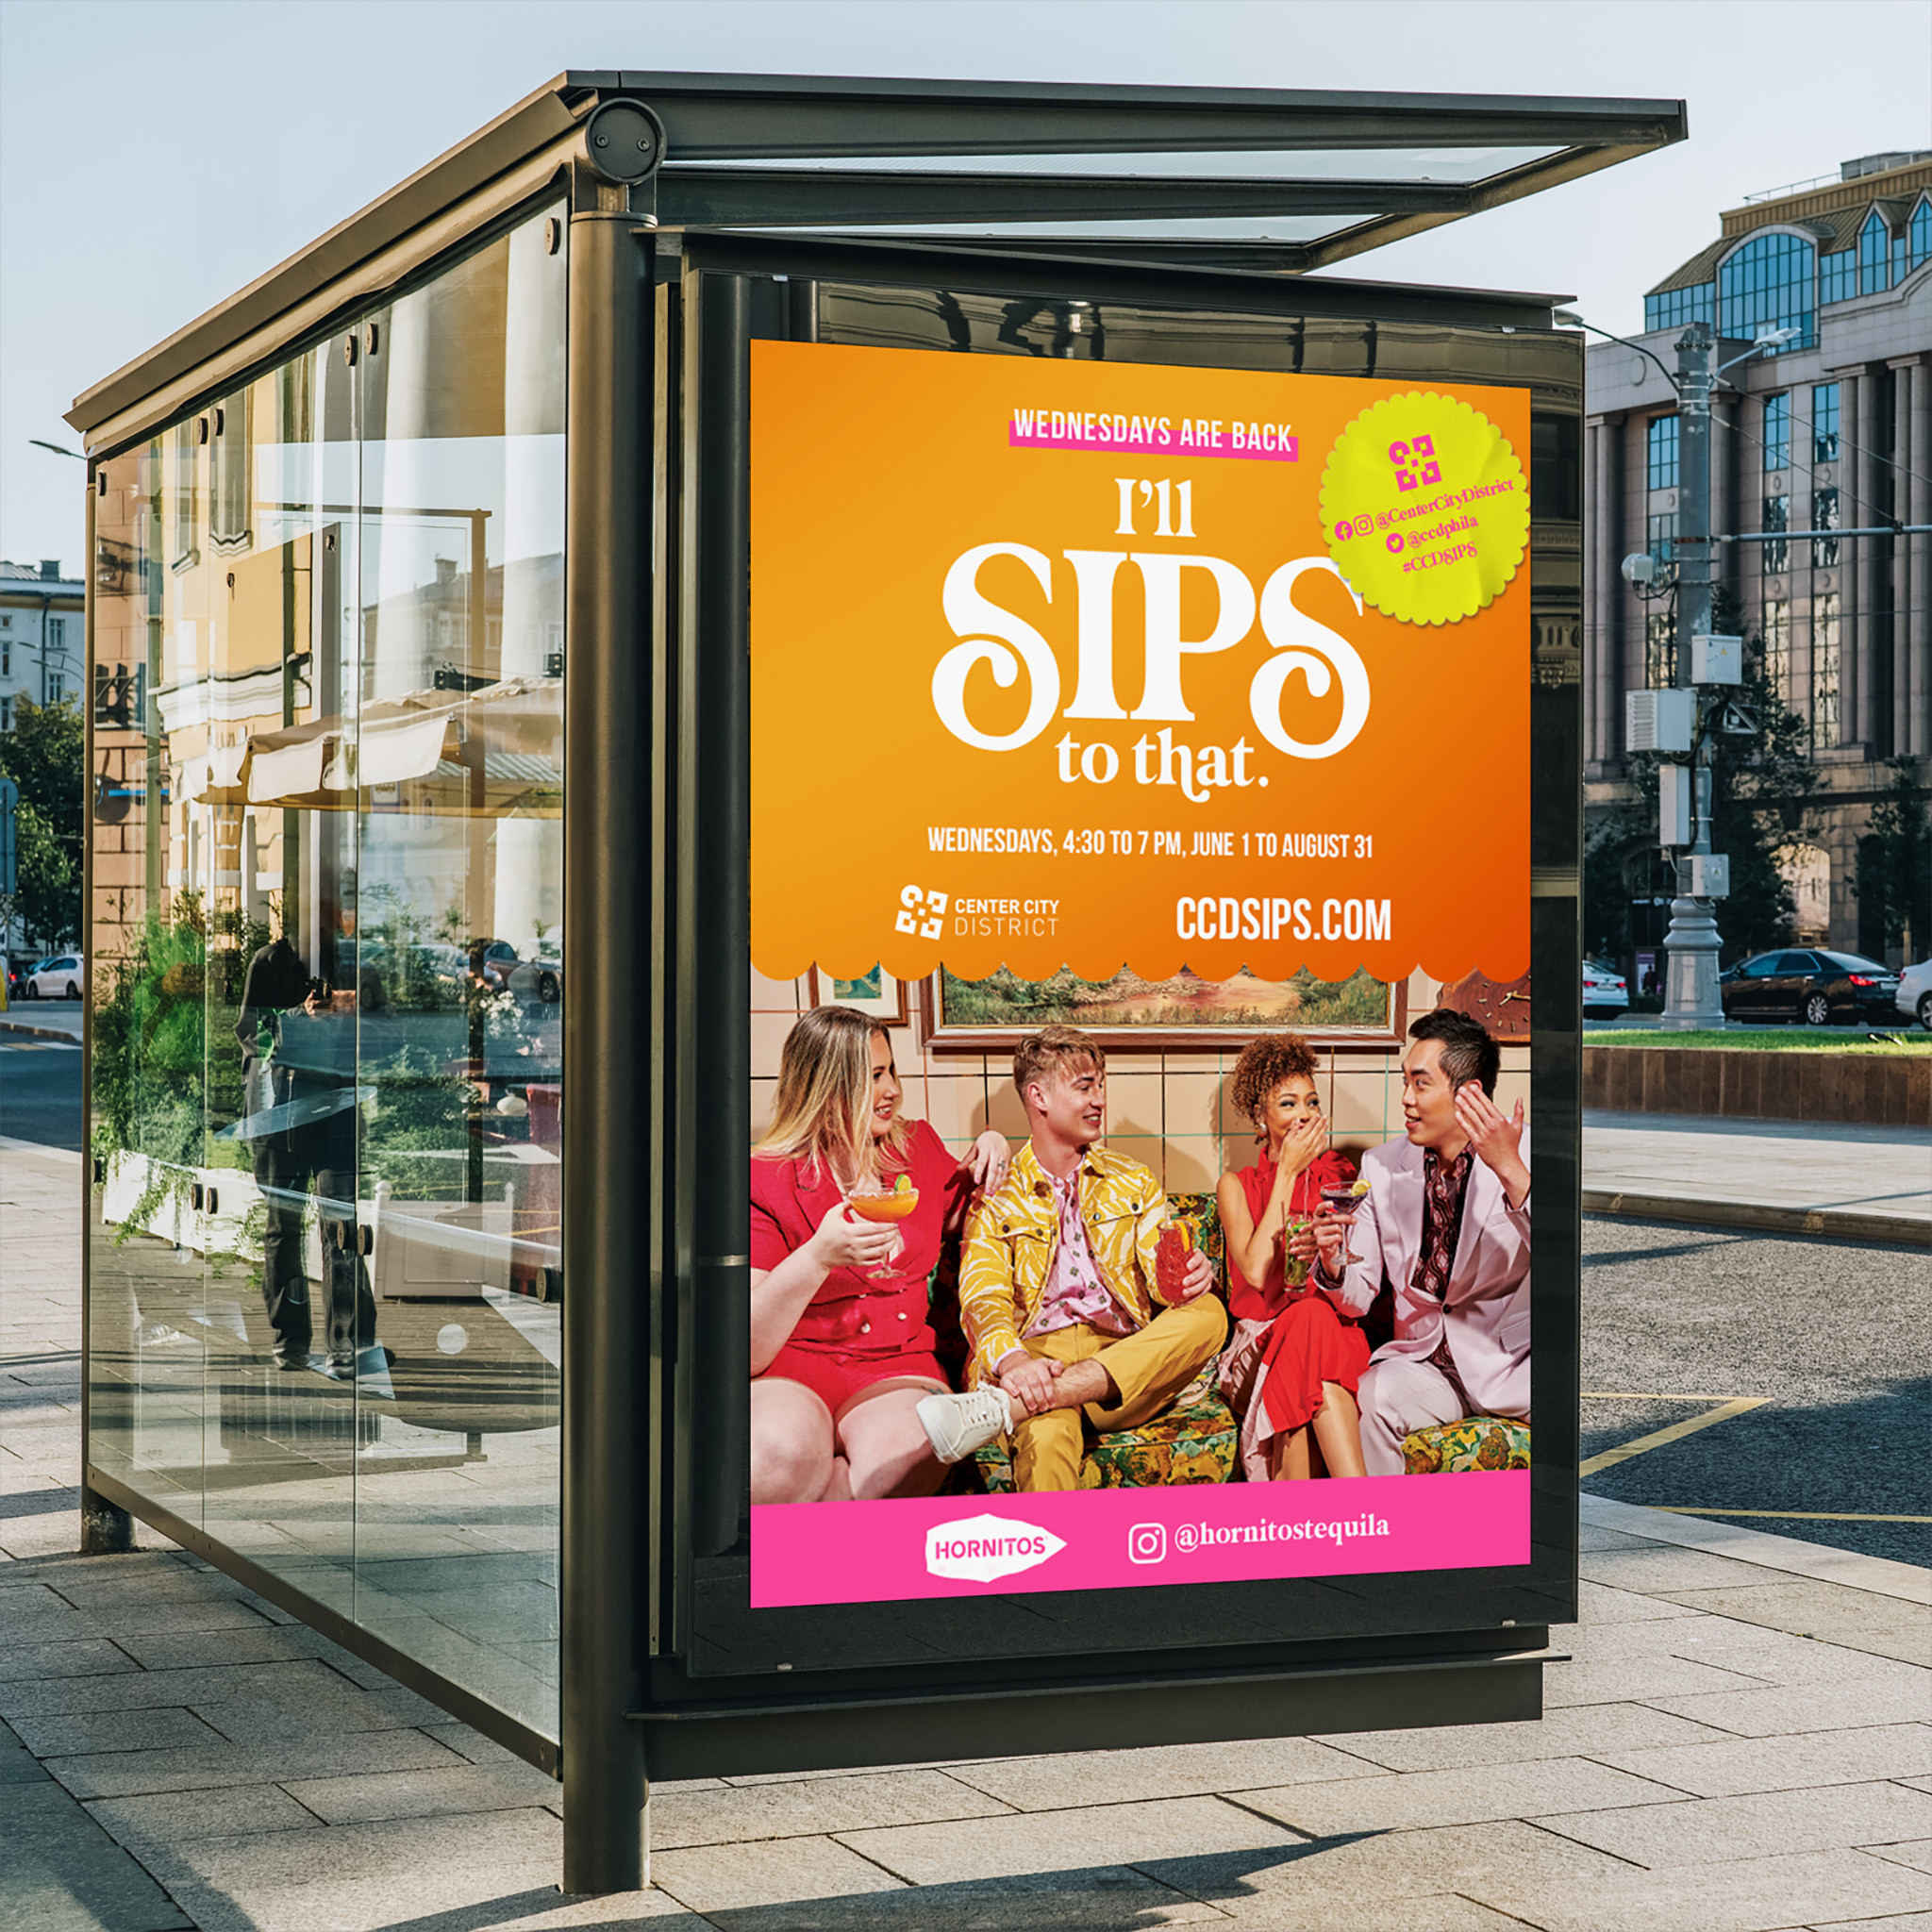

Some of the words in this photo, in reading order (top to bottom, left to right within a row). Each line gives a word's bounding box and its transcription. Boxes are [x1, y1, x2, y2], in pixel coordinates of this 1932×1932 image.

[1014, 408, 1171, 445] WEDNESDAYS
[1179, 418, 1223, 448] ARE
[1232, 421, 1291, 452] BACK
[1375, 478, 1515, 529] @CenterCityDistrict
[1407, 514, 1479, 549] @ccdphila
[1403, 541, 1478, 575] #CCDSIPS
[931, 541, 1371, 759] SIPS
[1055, 731, 1120, 784] to
[1131, 726, 1269, 804] that.
[927, 826, 1058, 857] WEDNESDAYS,
[1062, 829, 1105, 855] 4:30
[1109, 830, 1132, 855] TO
[1138, 830, 1149, 855] 7
[1154, 830, 1187, 858] PM,
[1191, 831, 1234, 857] JUNE
[1241, 832, 1250, 857] 1
[1255, 832, 1277, 857] TO
[1281, 833, 1350, 858] AUGUST
[1354, 834, 1373, 858] 31
[955, 898, 1021, 914] CENTER
[1024, 898, 1059, 914] CITY
[1176, 896, 1391, 941] CCDSIPS.COM
[955, 916, 1058, 937] DISTRICT
[936, 1536, 1046, 1559] HORNITOS
[1174, 1512, 1390, 1553] @hornitostequila
